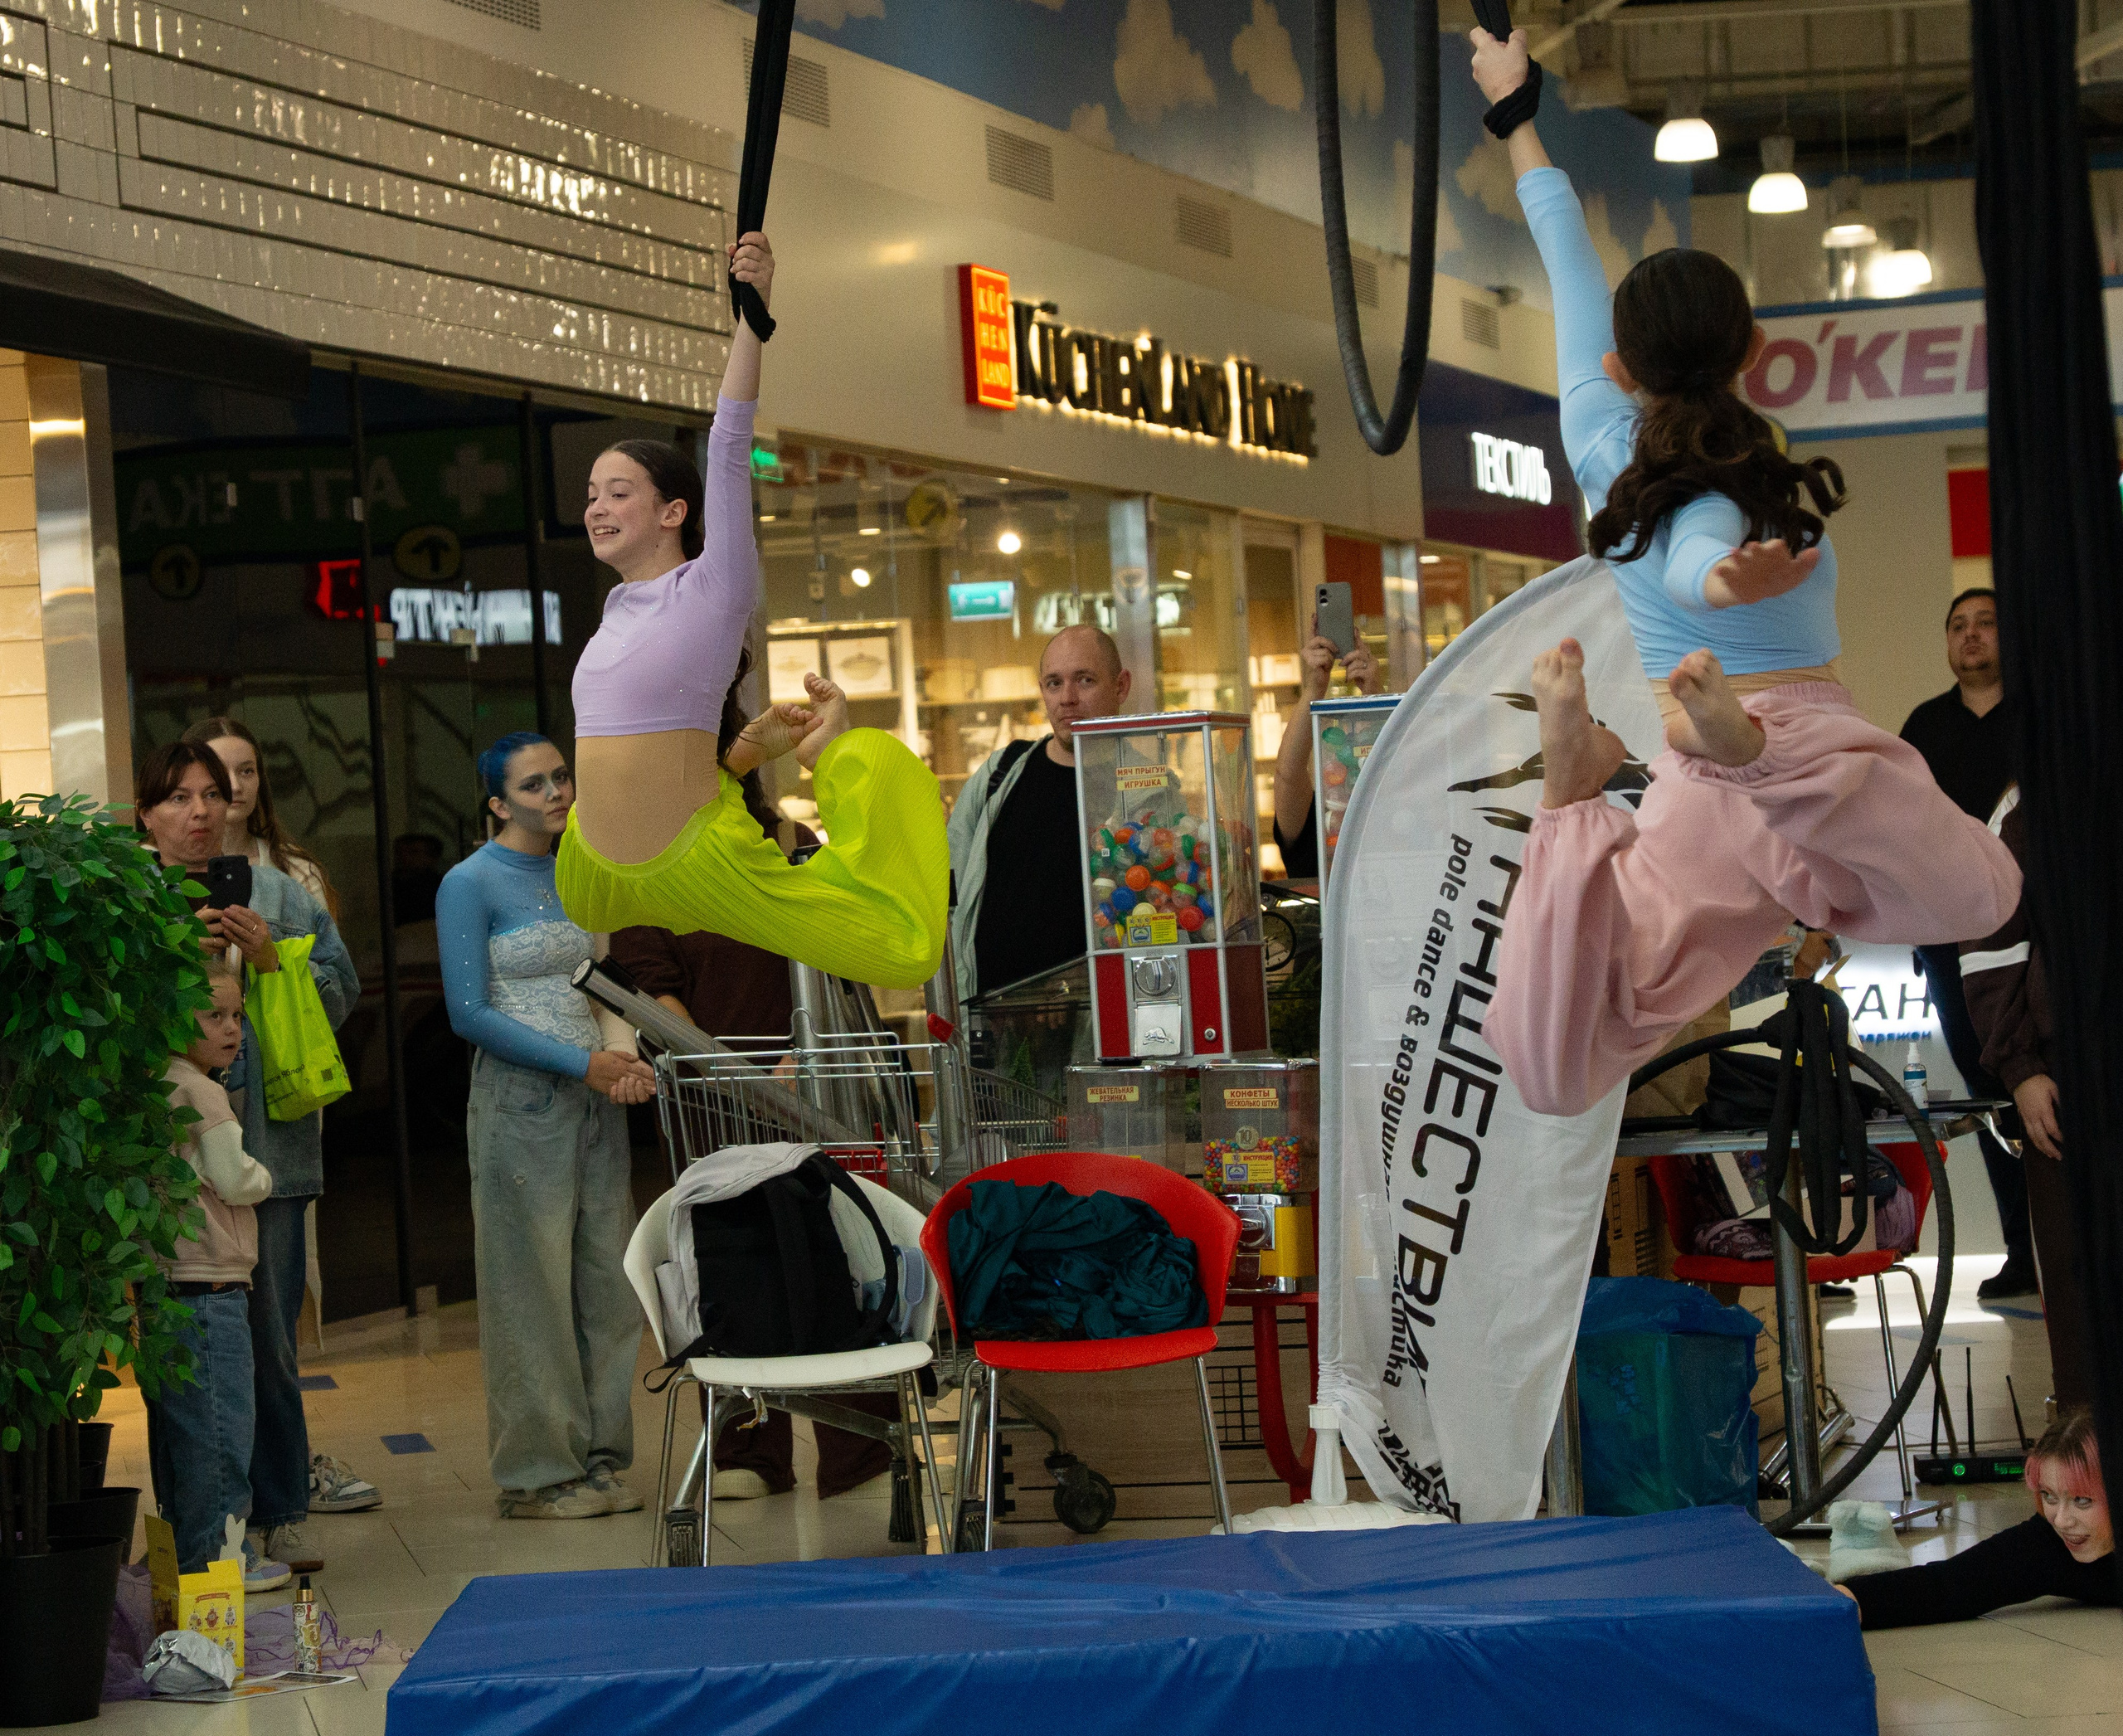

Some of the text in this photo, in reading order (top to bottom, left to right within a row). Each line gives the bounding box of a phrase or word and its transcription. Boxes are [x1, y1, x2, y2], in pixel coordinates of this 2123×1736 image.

[977, 284, 1006, 319] KÜC
[979, 322, 1008, 353] HEN
[981, 357, 1010, 388] LAND
[1744, 319, 1989, 409] О'КЕ
[1471, 431, 1552, 506] ТЕКСТИЛЬ
[1117, 766, 1166, 776] МЯЧ ПРЫГУН
[1125, 778, 1162, 789] ИГРУШКА
[1440, 833, 1473, 902] pole
[1413, 907, 1455, 999] dance
[1405, 1004, 1430, 1027] &
[1090, 1087, 1134, 1095] ЖЕВАТЕЛЬНАЯ
[1261, 1099, 1278, 1107] ШТУК
